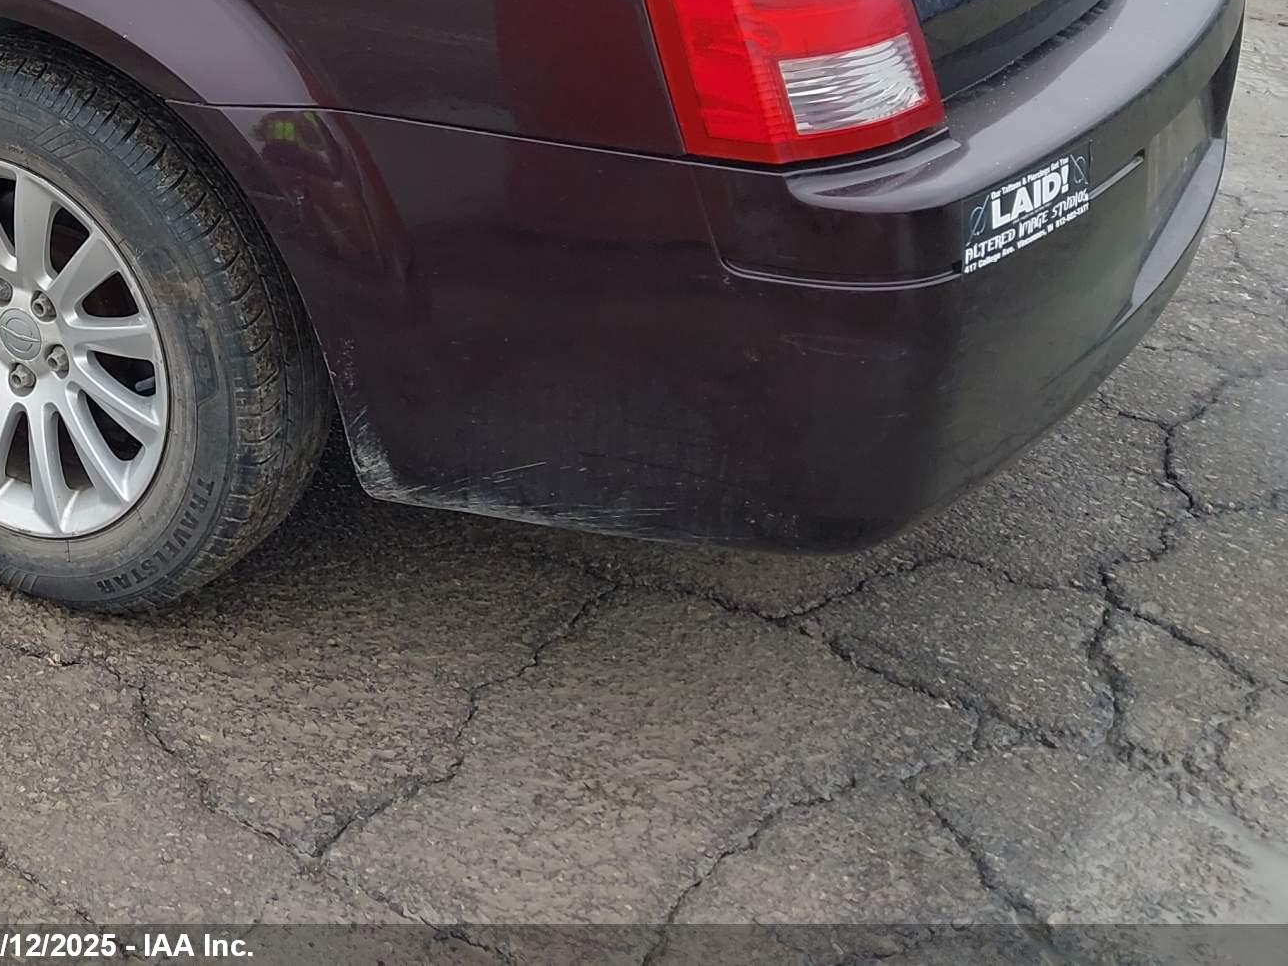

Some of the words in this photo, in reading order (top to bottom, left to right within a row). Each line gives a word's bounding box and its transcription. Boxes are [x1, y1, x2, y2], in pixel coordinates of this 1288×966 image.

[964, 227, 1016, 265] ALTERED
[1018, 211, 1049, 239] IMAGE
[1051, 188, 1089, 219] STUDIOS
[991, 164, 1069, 230] LAID!
[96, 477, 216, 594] TRAVELSTAR
